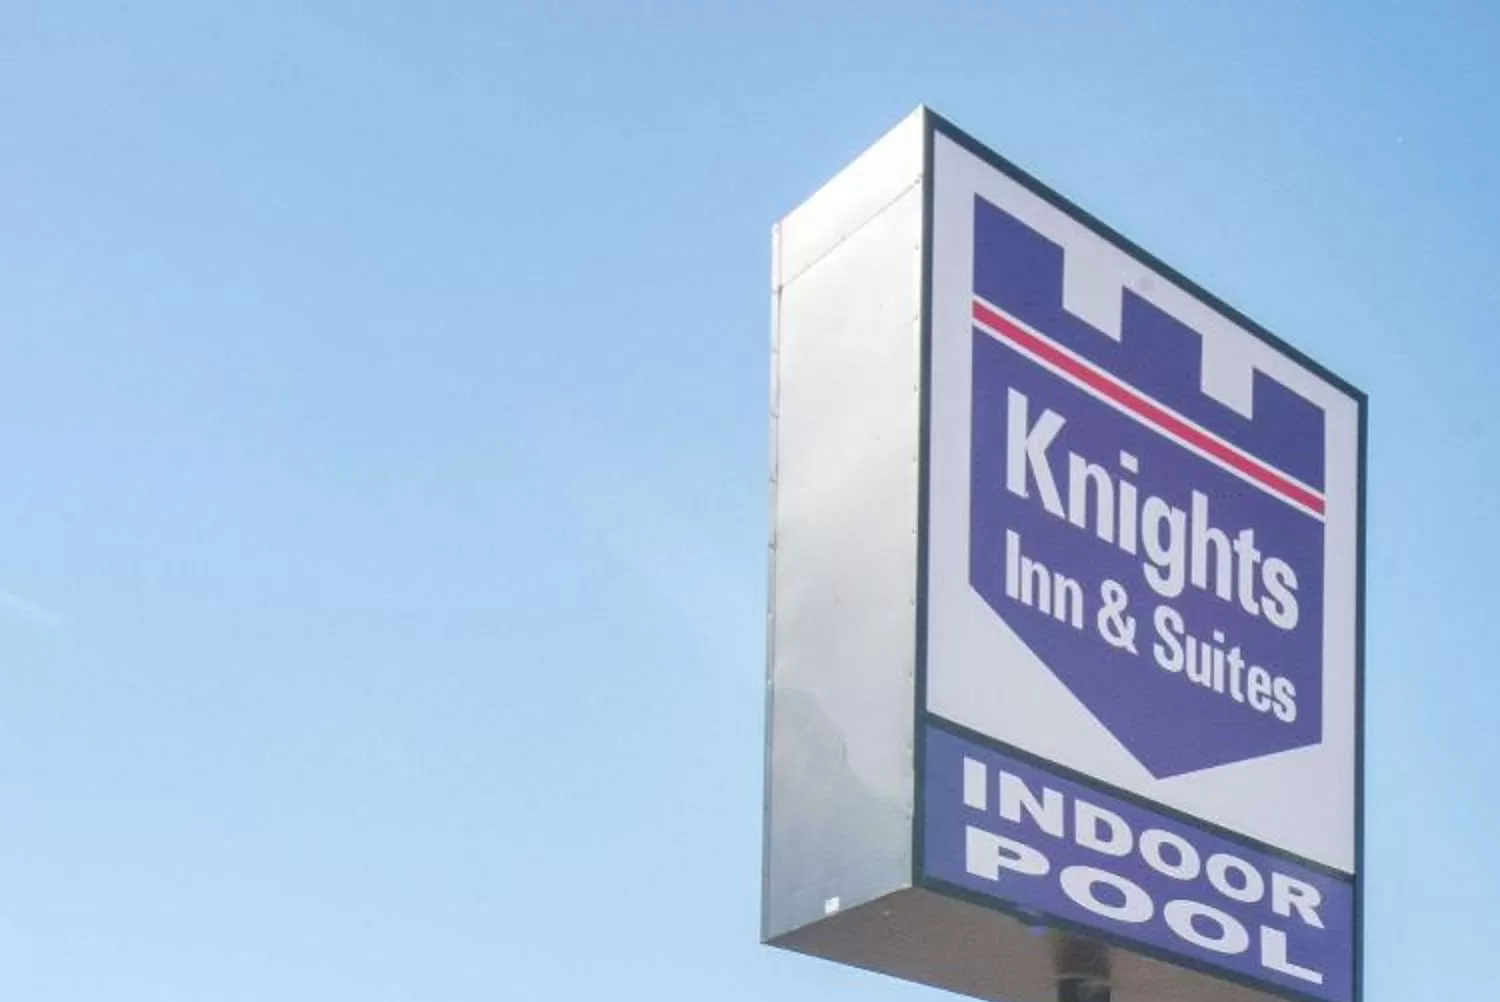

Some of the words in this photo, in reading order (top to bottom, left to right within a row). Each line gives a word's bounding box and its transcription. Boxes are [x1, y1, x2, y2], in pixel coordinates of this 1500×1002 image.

[1005, 386, 1300, 631] Knights
[1004, 527, 1086, 632] Inn
[1095, 578, 1140, 656] &
[1152, 603, 1298, 724] Suites
[962, 756, 1325, 929] INDOOR
[964, 824, 1324, 985] POOL
